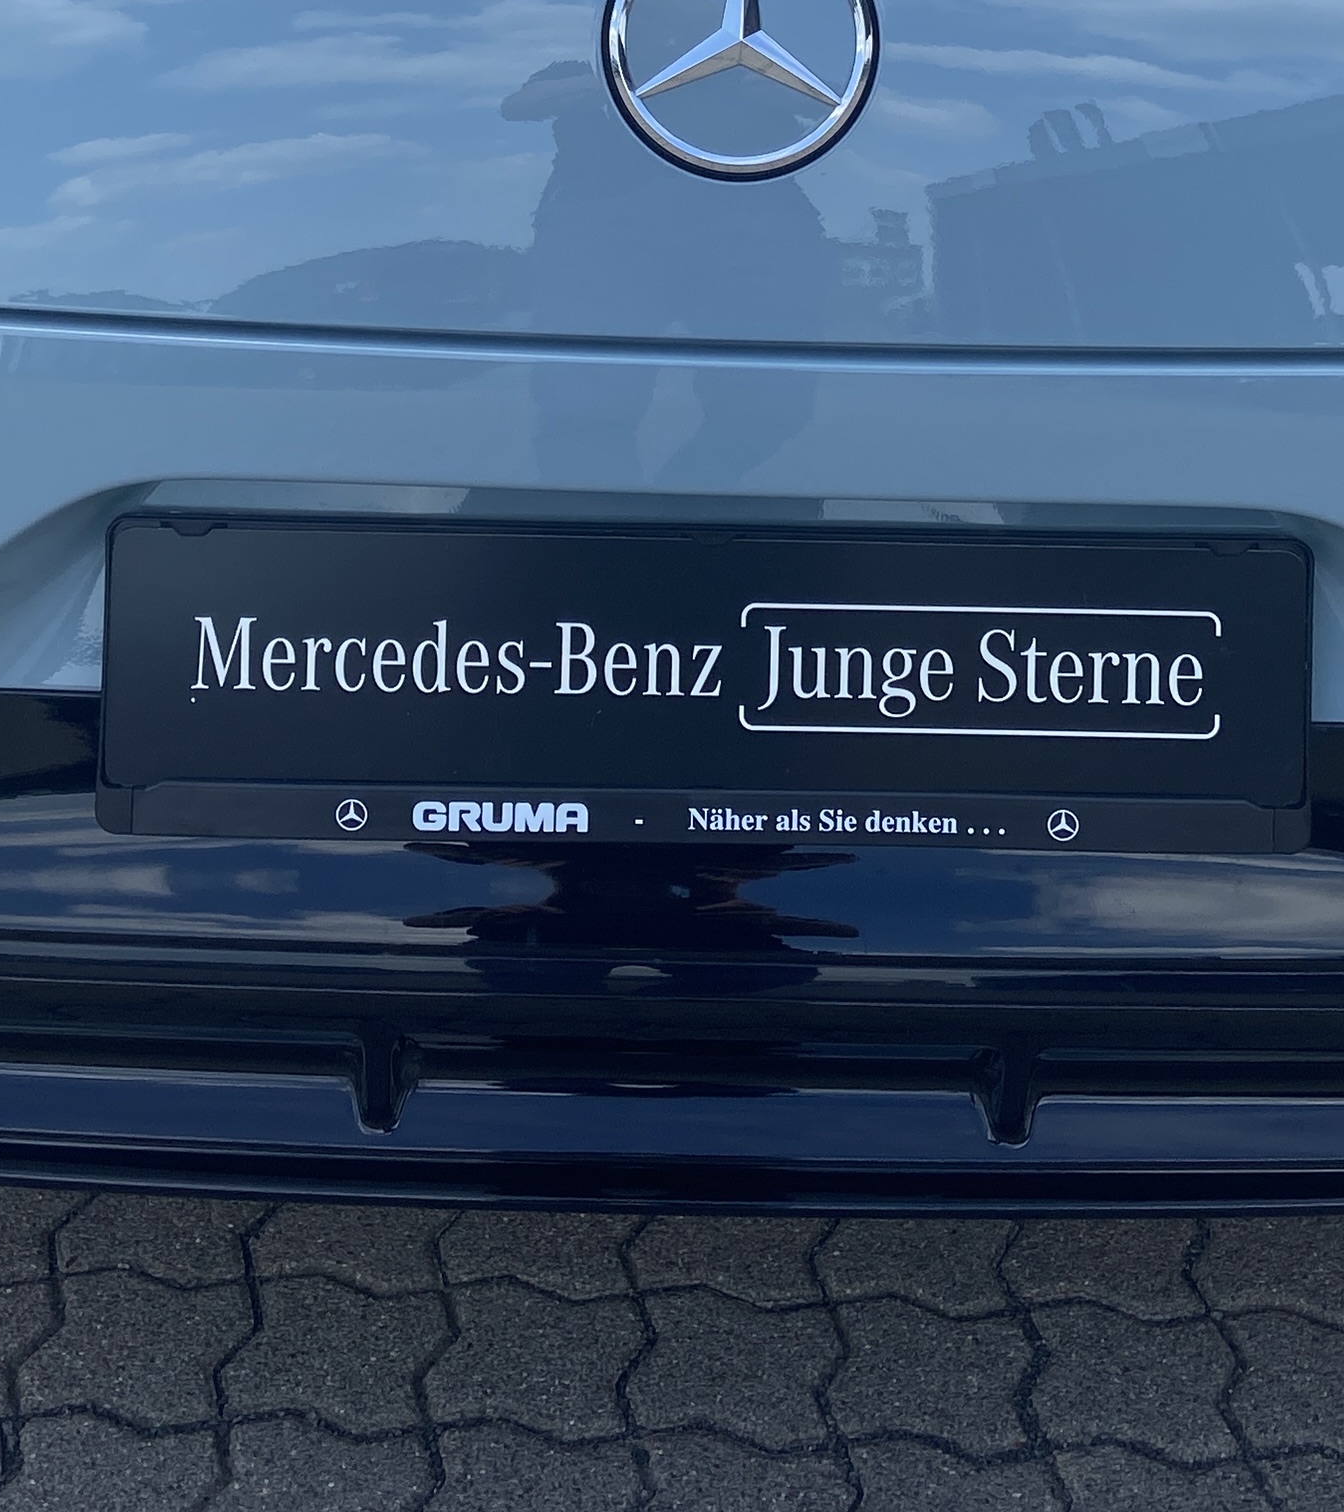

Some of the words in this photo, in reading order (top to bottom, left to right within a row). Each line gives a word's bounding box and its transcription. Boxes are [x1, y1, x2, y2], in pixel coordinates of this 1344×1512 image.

[190, 616, 723, 697] Mercedes-Benz
[757, 625, 954, 718] Junge
[978, 629, 1203, 706] Sterne
[411, 801, 589, 833] GRUMA
[687, 807, 769, 831] Näher
[775, 808, 811, 832] als
[818, 808, 858, 833] Sie
